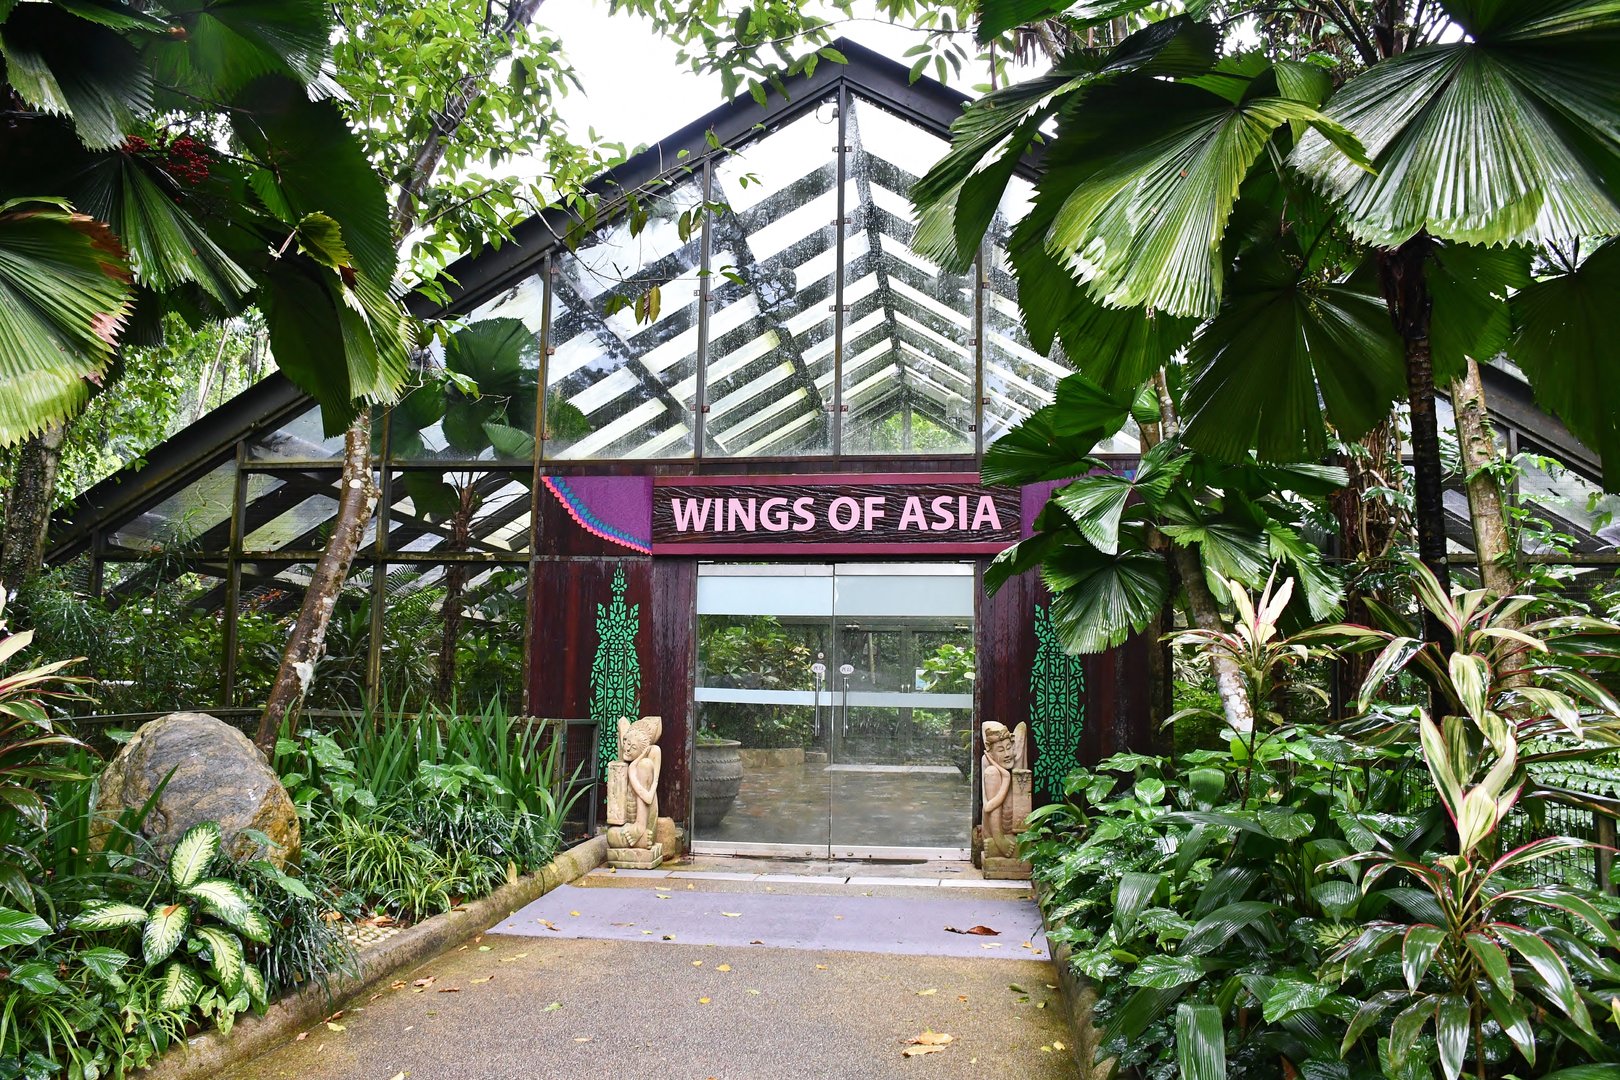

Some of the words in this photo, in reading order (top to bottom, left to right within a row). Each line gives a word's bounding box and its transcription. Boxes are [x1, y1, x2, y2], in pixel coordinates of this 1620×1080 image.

[671, 497, 815, 532] WINGS
[828, 496, 886, 531] OF
[898, 495, 1002, 531] ASIA
